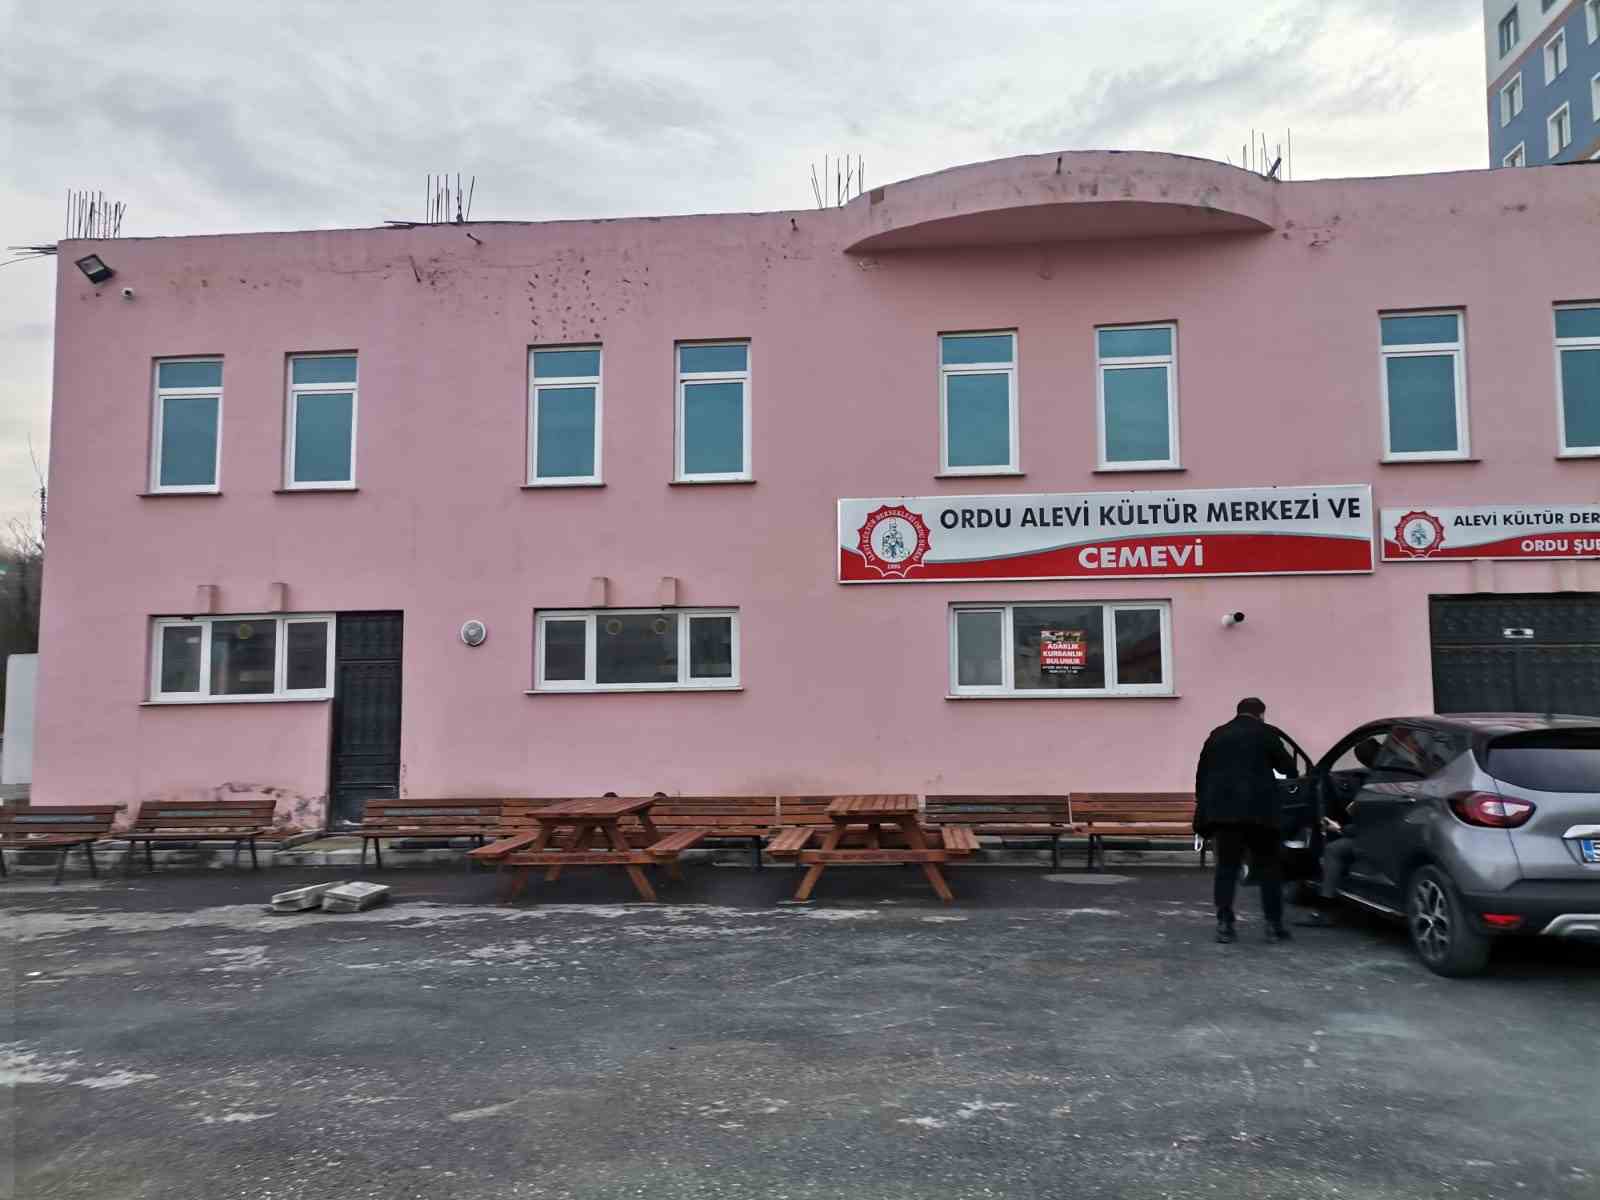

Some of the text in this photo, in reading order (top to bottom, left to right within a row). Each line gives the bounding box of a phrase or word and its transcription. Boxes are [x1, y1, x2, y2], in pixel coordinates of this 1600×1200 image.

[940, 494, 1361, 529] ORDU ALEVİ KÜLTÜR MERKEZİ VE
[1454, 512, 1497, 526] ALEVİ
[1503, 510, 1564, 526] KÜLTÜR
[1078, 539, 1204, 569] CEMEVİ
[1521, 539, 1569, 553] ORDU
